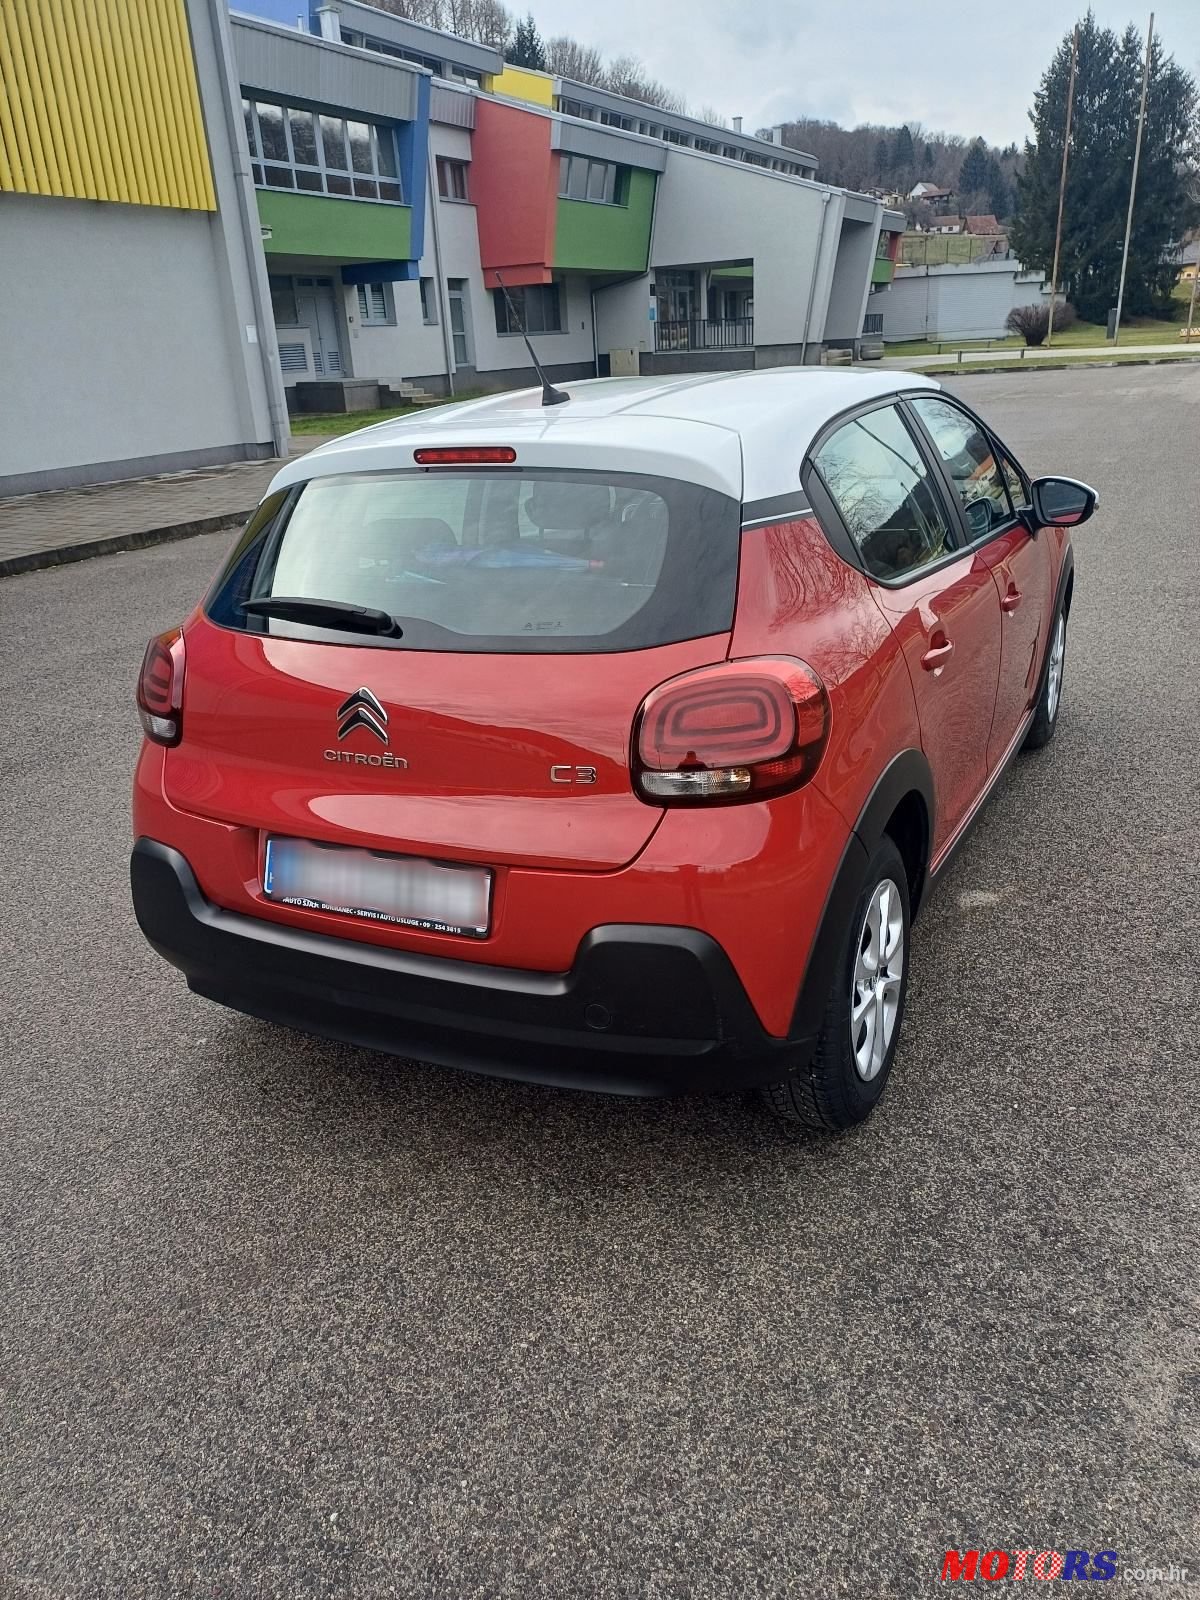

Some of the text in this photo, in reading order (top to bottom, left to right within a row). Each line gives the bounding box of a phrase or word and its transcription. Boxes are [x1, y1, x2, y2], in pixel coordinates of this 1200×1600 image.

[323, 749, 408, 769] CITROËN
[550, 765, 597, 784] C3
[380, 913, 396, 922] AUTO
